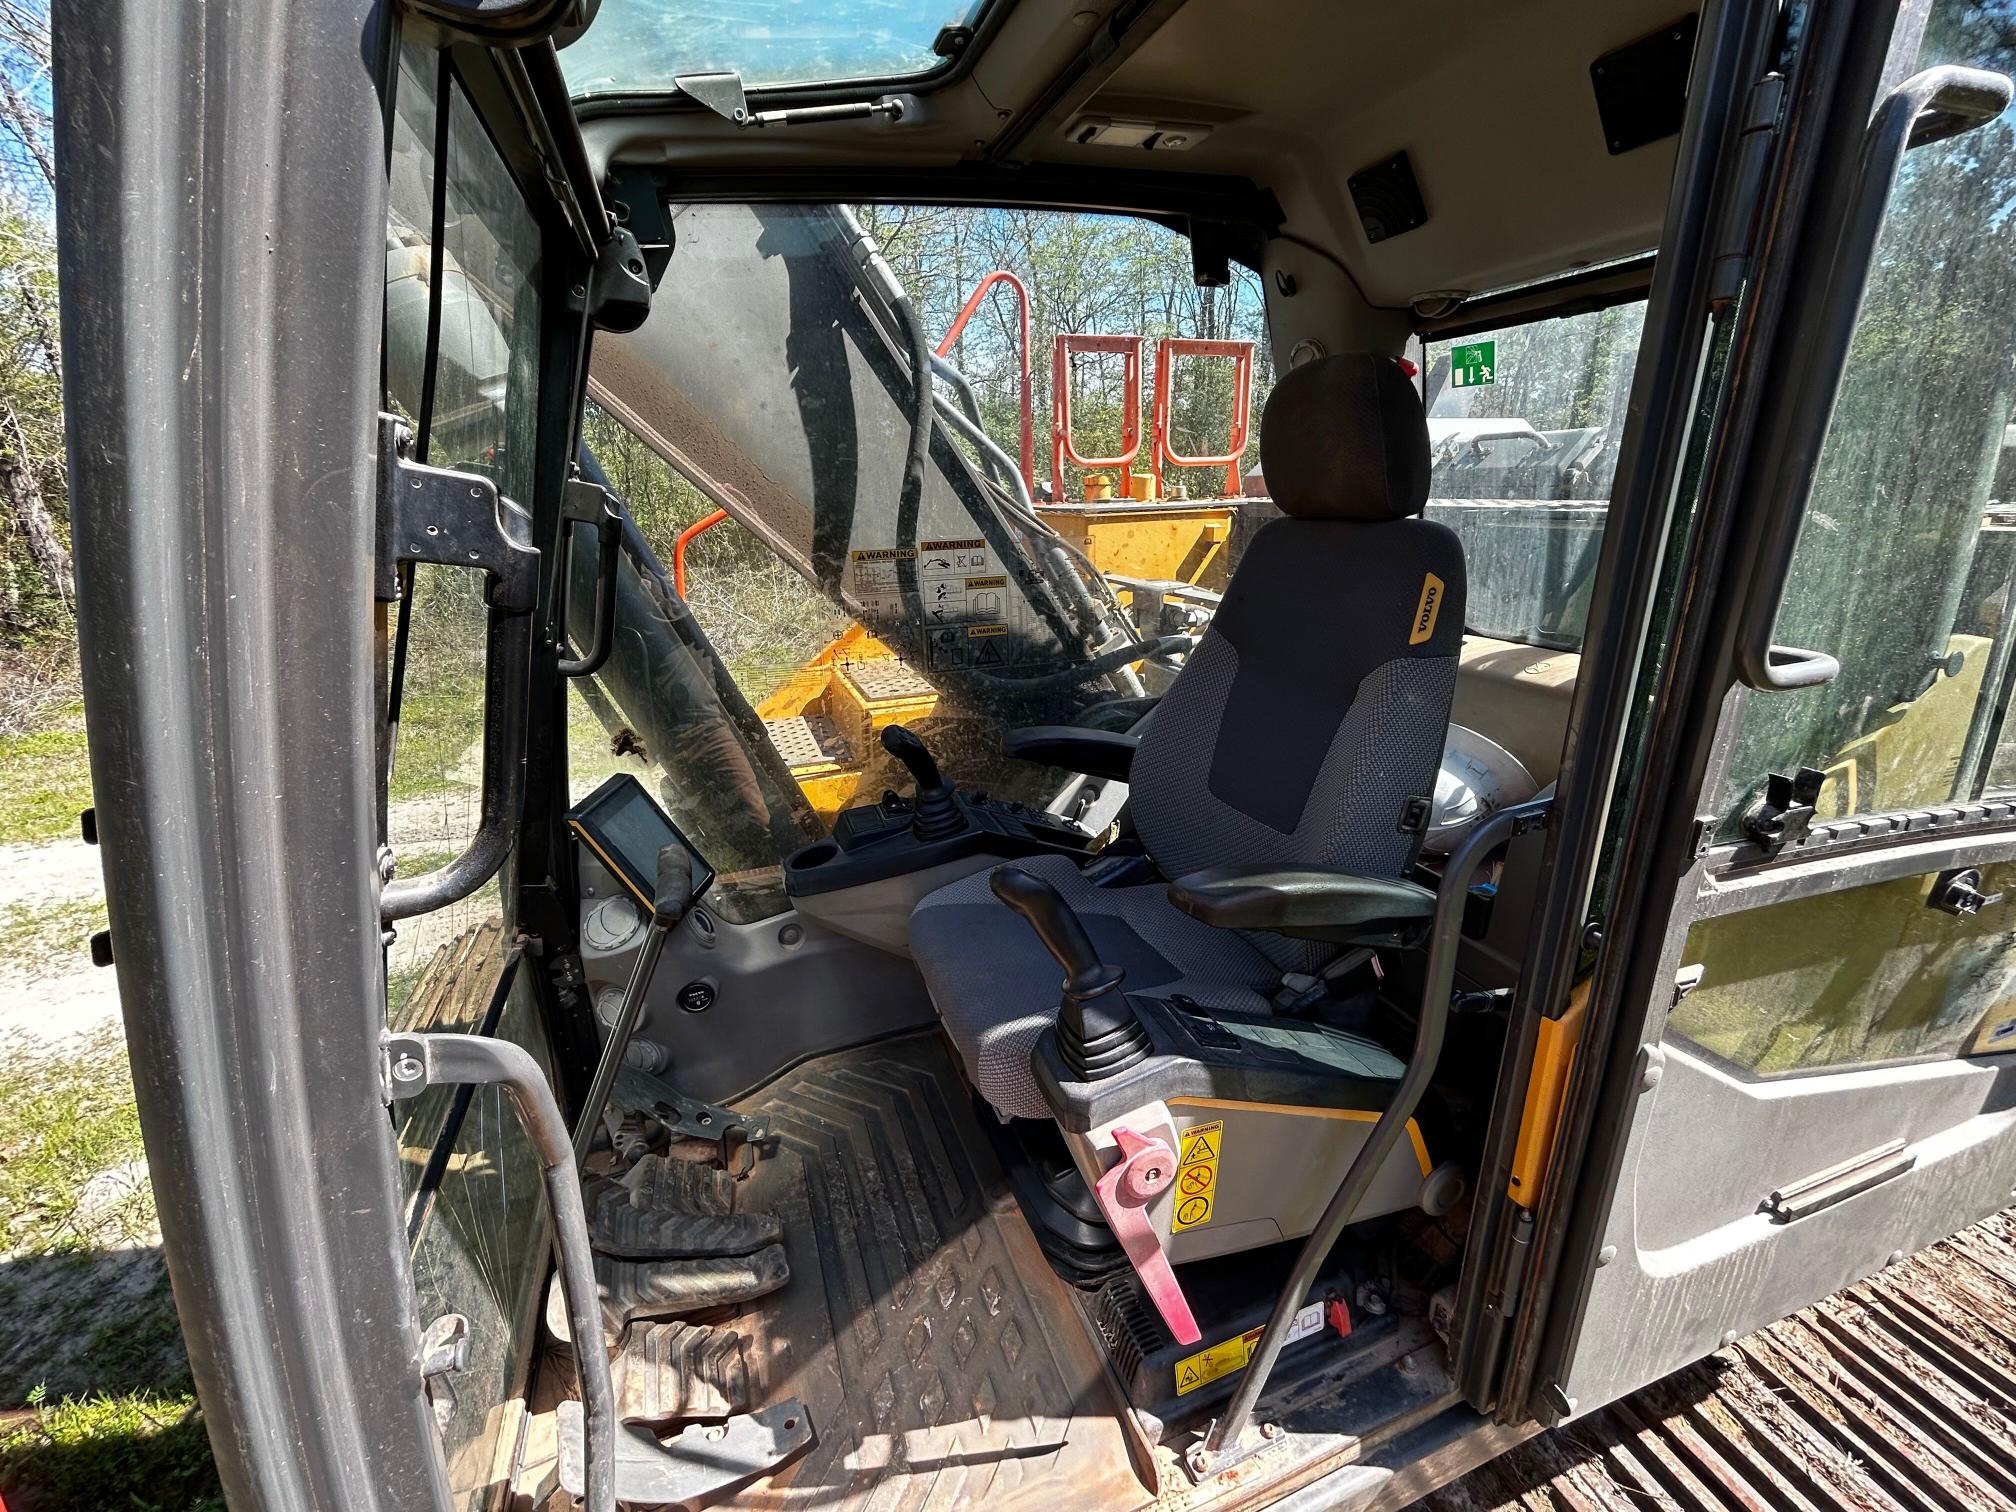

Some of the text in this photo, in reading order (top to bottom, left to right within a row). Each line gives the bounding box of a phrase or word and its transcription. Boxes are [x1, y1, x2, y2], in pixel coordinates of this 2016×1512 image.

[931, 539, 981, 550] WARNING
[866, 550, 914, 560] WARNING
[973, 579, 1004, 587] WARNING
[1418, 587, 1437, 632] VOLVO
[976, 627, 1007, 635] WARNING
[1191, 1124, 1219, 1136] WARNING
